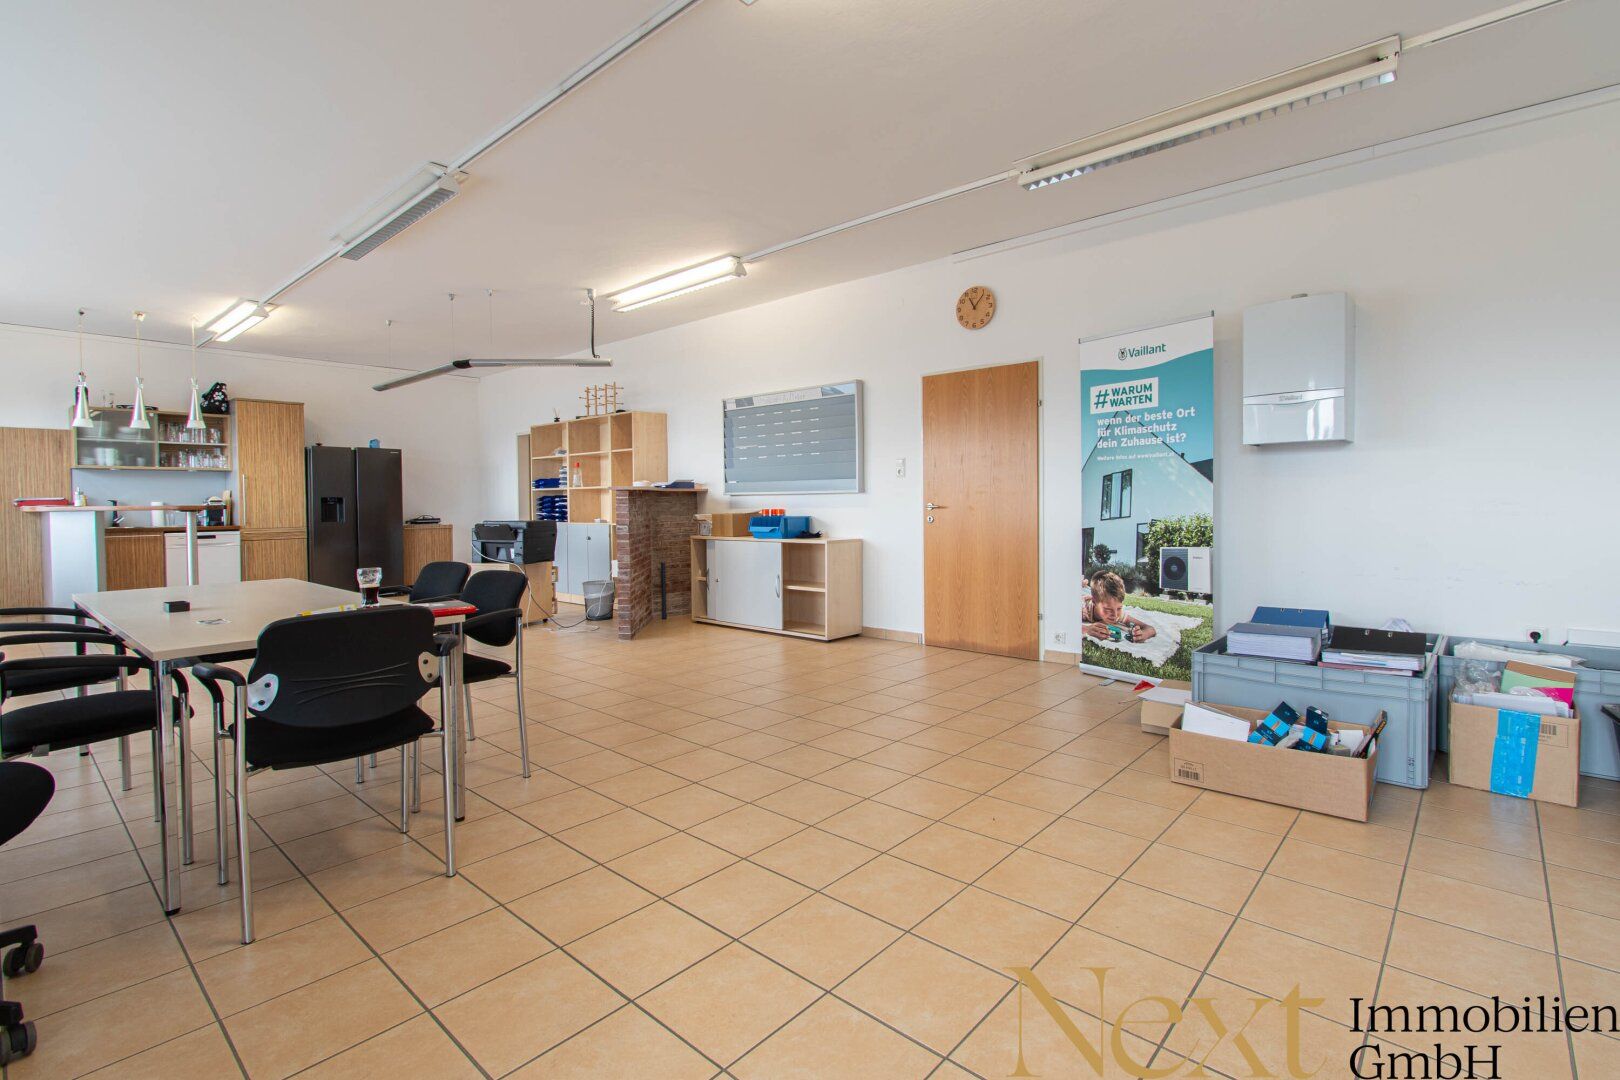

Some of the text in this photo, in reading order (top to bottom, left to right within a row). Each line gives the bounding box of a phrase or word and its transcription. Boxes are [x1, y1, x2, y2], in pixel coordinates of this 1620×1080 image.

[1128, 343, 1167, 358] Vaillant
[1109, 394, 1153, 408] WARTEN
[1097, 406, 1196, 426] wenn der beste Ort
[1097, 422, 1177, 438] für Klimaschutz
[1097, 433, 1187, 449] dein Zuhause ist?
